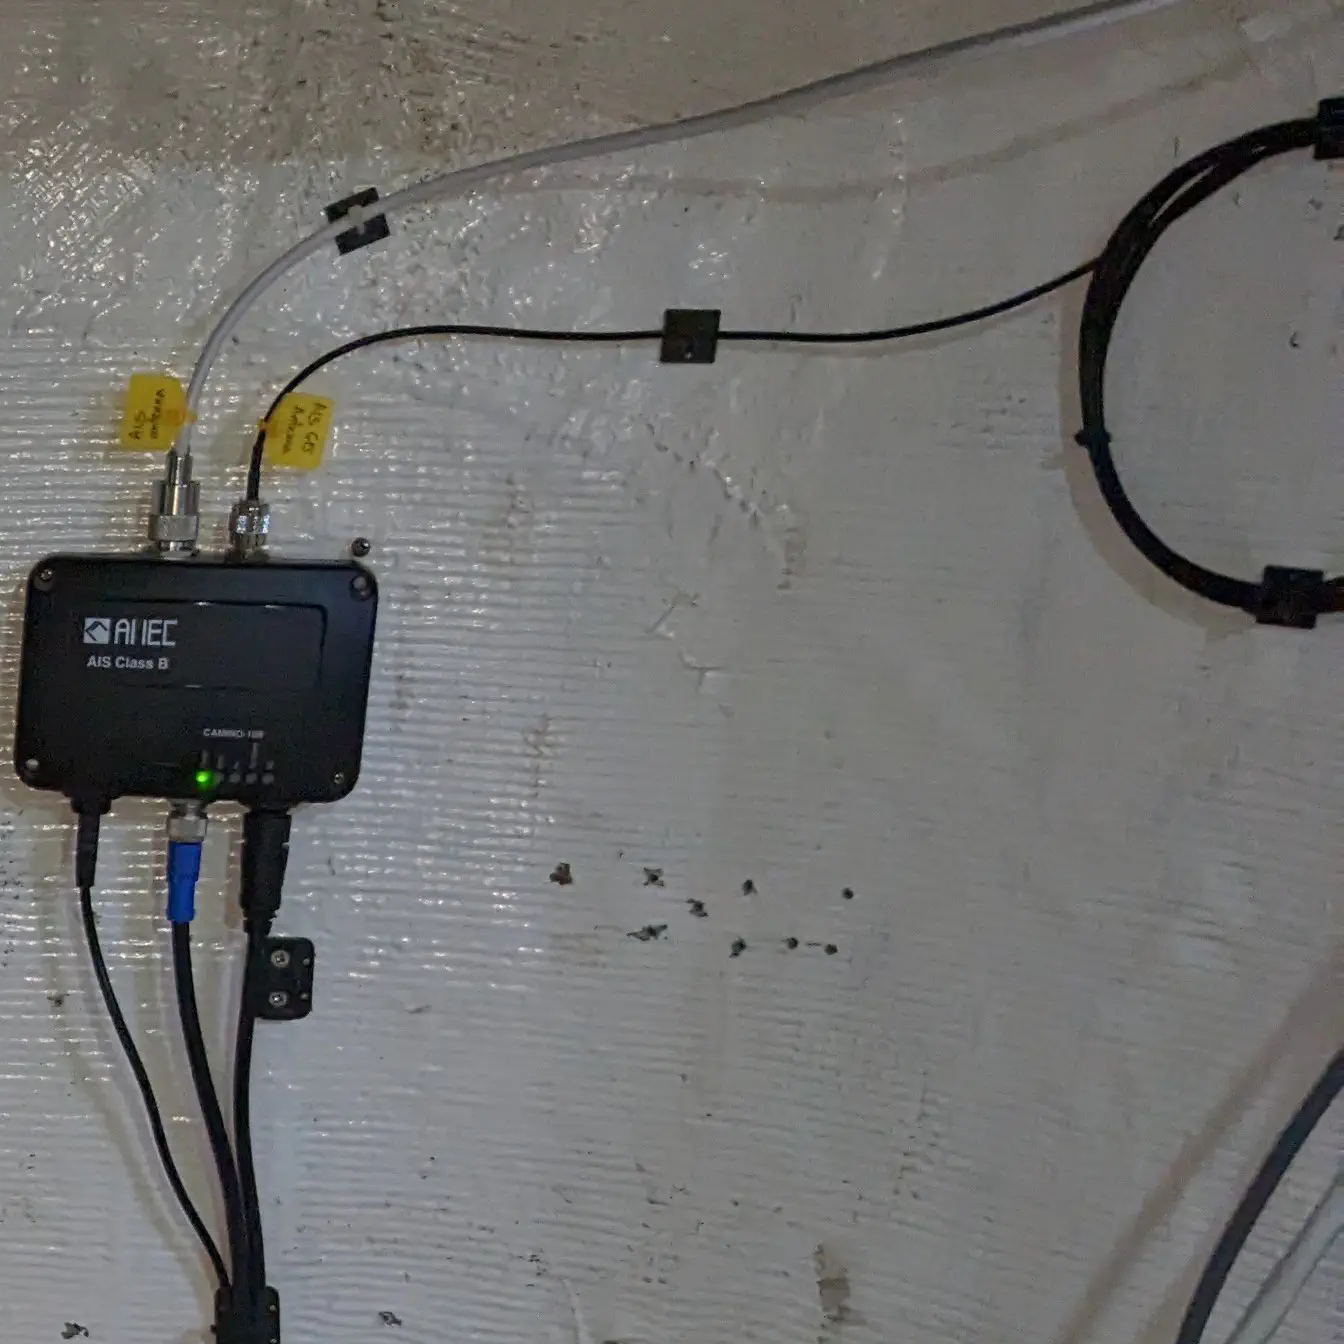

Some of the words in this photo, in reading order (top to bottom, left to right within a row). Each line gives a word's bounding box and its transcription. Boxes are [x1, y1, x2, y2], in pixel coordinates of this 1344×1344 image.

[86, 655, 112, 669] AIS
[115, 655, 154, 670] Class
[157, 657, 170, 670] B
